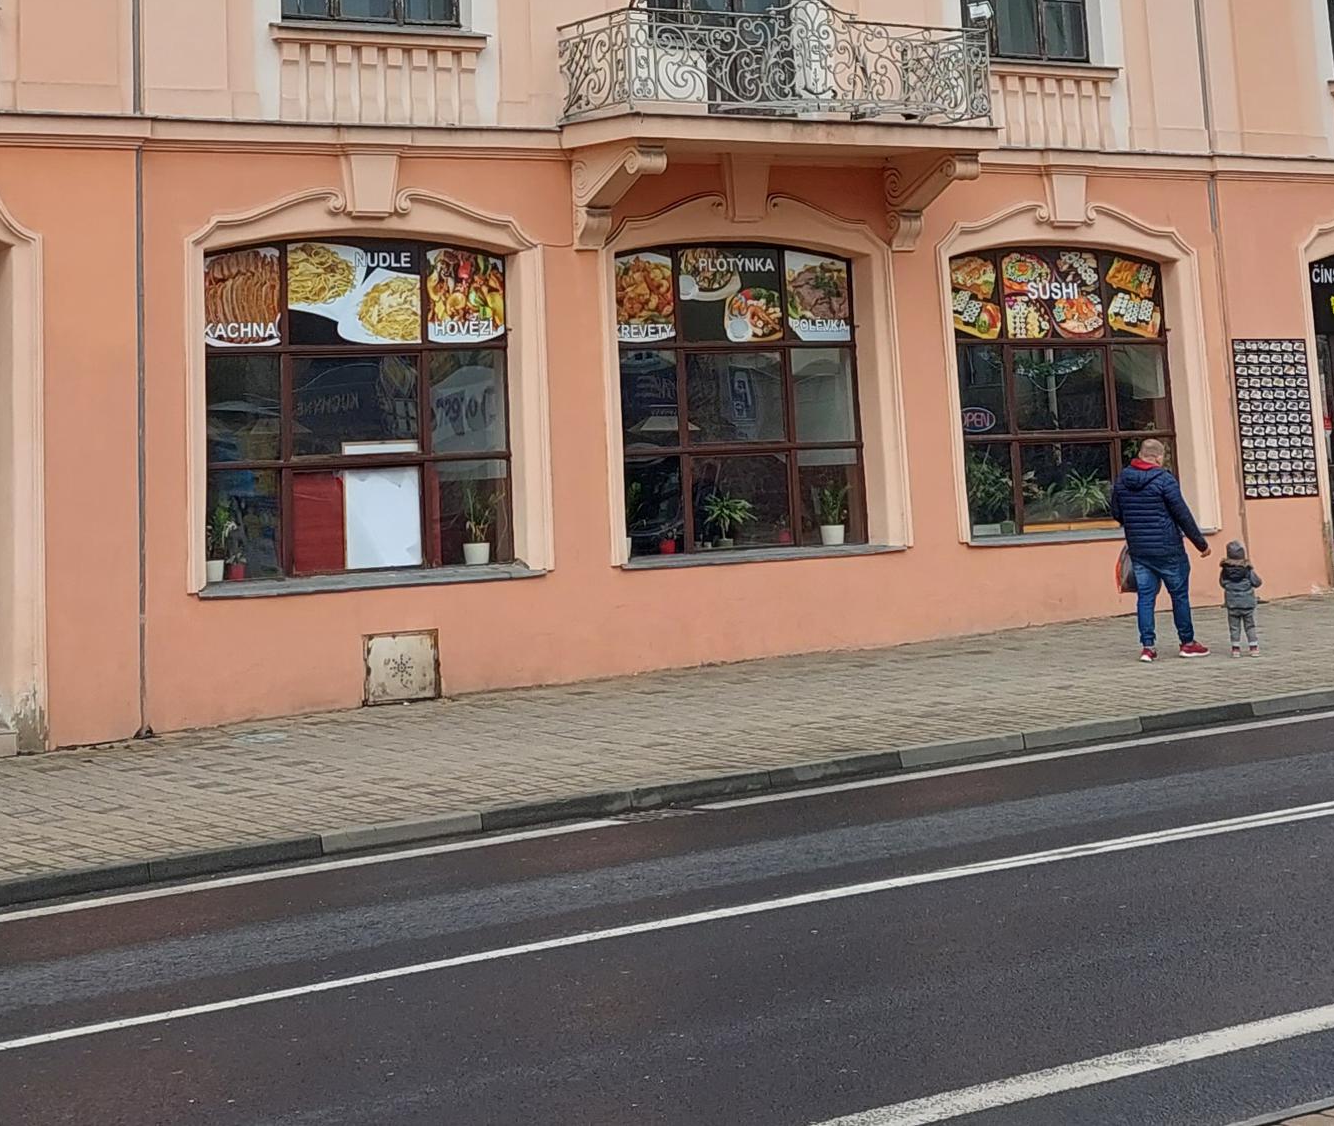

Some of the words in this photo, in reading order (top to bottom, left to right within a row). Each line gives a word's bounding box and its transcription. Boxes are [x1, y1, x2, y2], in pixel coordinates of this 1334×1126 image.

[355, 251, 411, 268] NUDLE
[1027, 282, 1078, 300] SUSHI
[204, 322, 277, 338] KACHNA
